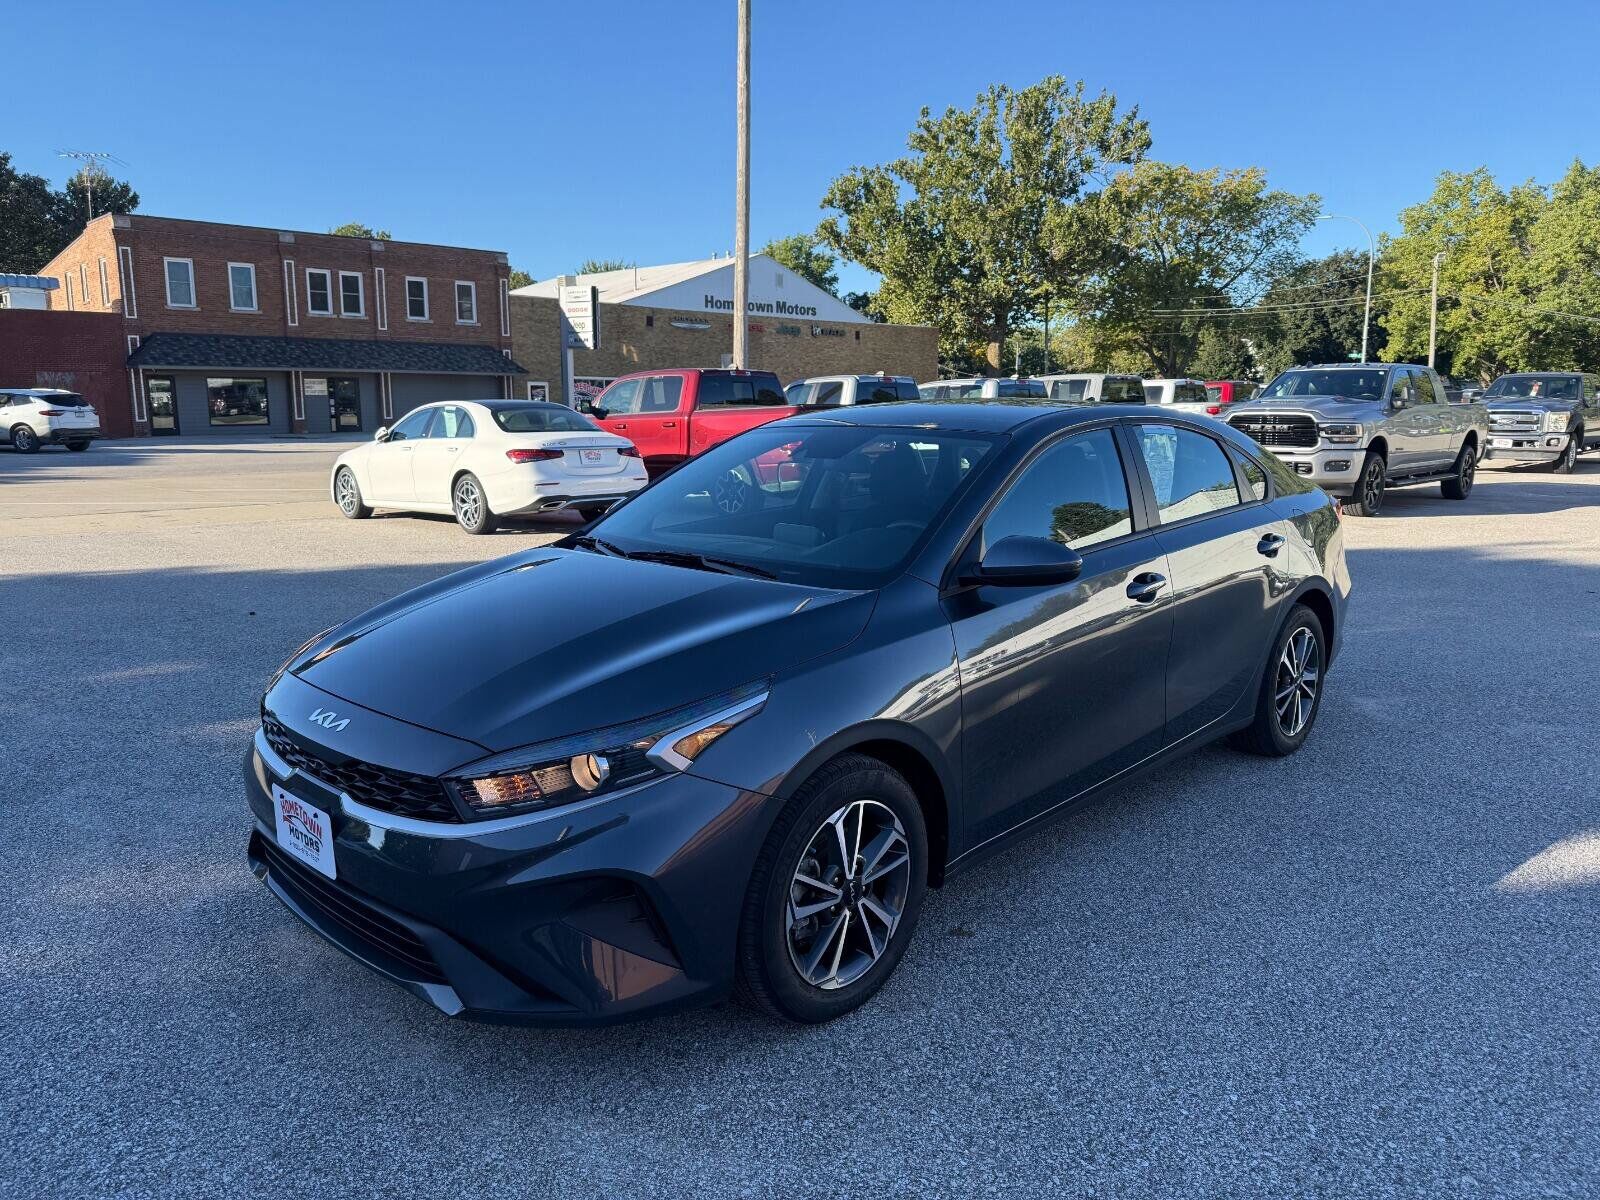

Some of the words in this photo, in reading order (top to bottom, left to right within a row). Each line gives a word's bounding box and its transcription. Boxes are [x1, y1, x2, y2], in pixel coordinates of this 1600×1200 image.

[704, 294, 774, 313] Homown
[775, 300, 817, 317] Motors
[308, 707, 351, 732] KIA
[281, 799, 322, 839] HOMETOWN
[288, 823, 321, 854] MOTORS
